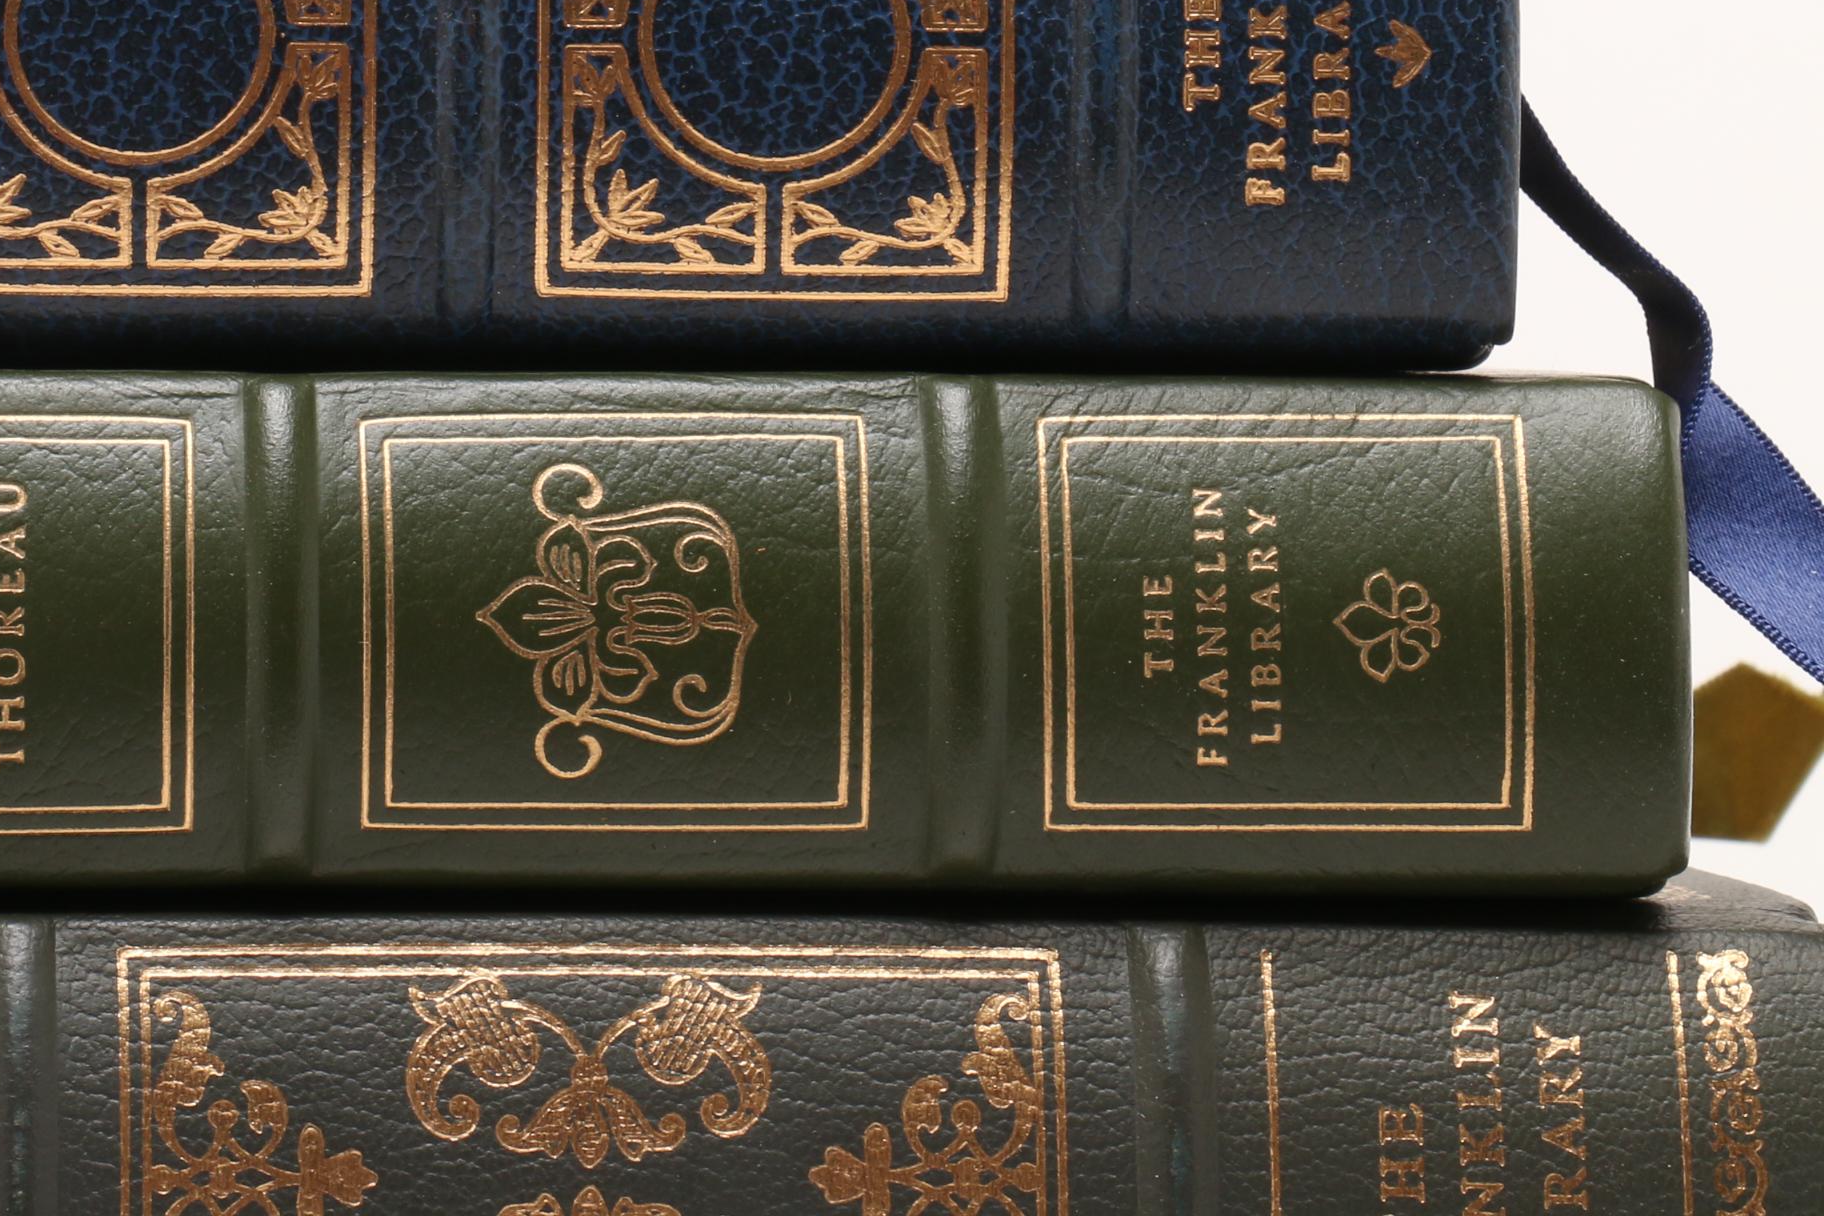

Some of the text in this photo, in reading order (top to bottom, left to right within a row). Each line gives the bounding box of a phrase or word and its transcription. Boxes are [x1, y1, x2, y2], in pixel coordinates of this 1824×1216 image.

[1143, 575, 1174, 679] THE
[1192, 487, 1229, 767] FRANKLIN
[1246, 508, 1282, 745] LIBRARY
[1379, 1103, 1426, 1216] HE
